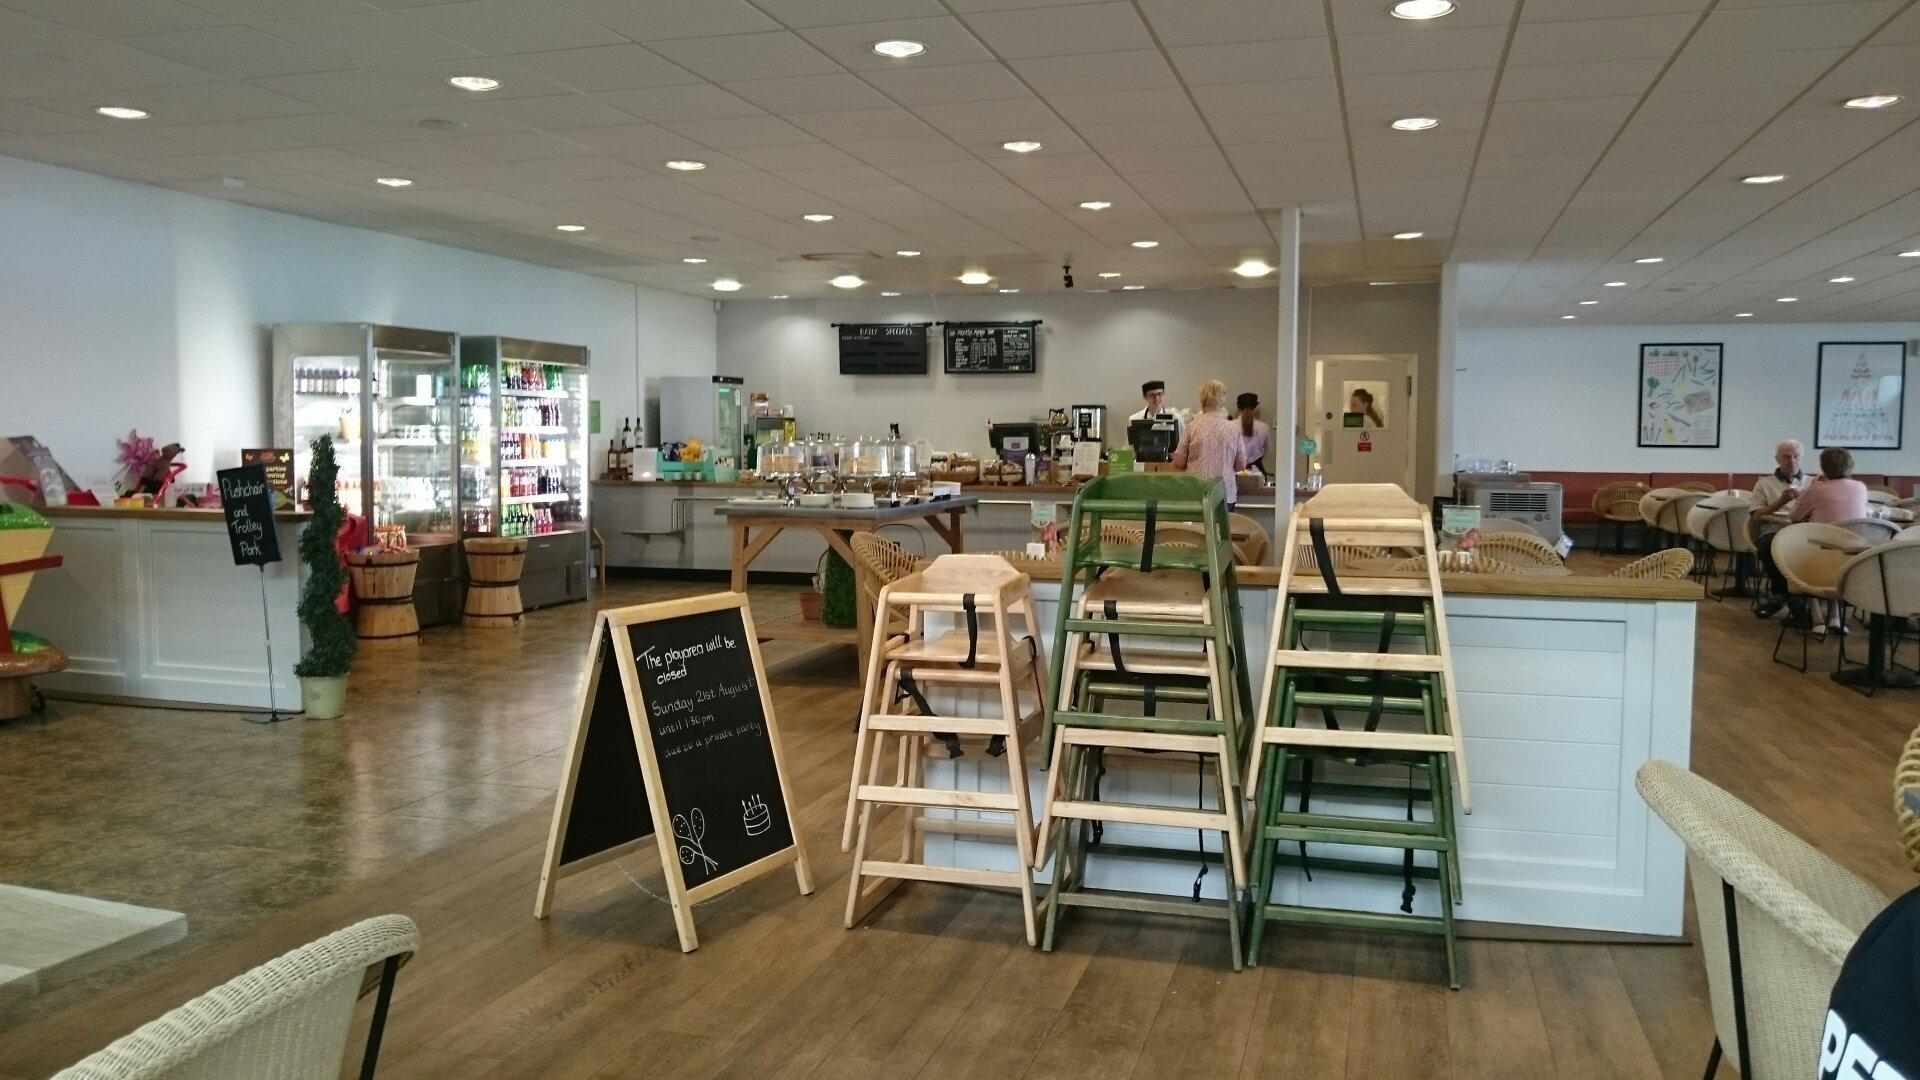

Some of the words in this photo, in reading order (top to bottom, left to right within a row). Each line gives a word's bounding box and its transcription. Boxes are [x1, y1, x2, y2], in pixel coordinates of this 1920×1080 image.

[221, 477, 265, 500] Pushchair
[233, 504, 249, 518] and
[231, 519, 263, 541] Trolley
[636, 645, 663, 670] The
[664, 643, 704, 671] playarea
[705, 634, 723, 652] will
[723, 636, 737, 649] be
[656, 666, 687, 685] closed
[651, 698, 694, 717] Sunday
[695, 689, 716, 703] 21st
[718, 675, 755, 698] August
[658, 719, 682, 736] until
[664, 745, 682, 758] due
[683, 742, 694, 752] to
[695, 738, 702, 747] a
[704, 729, 734, 749] private
[736, 722, 762, 738] party
